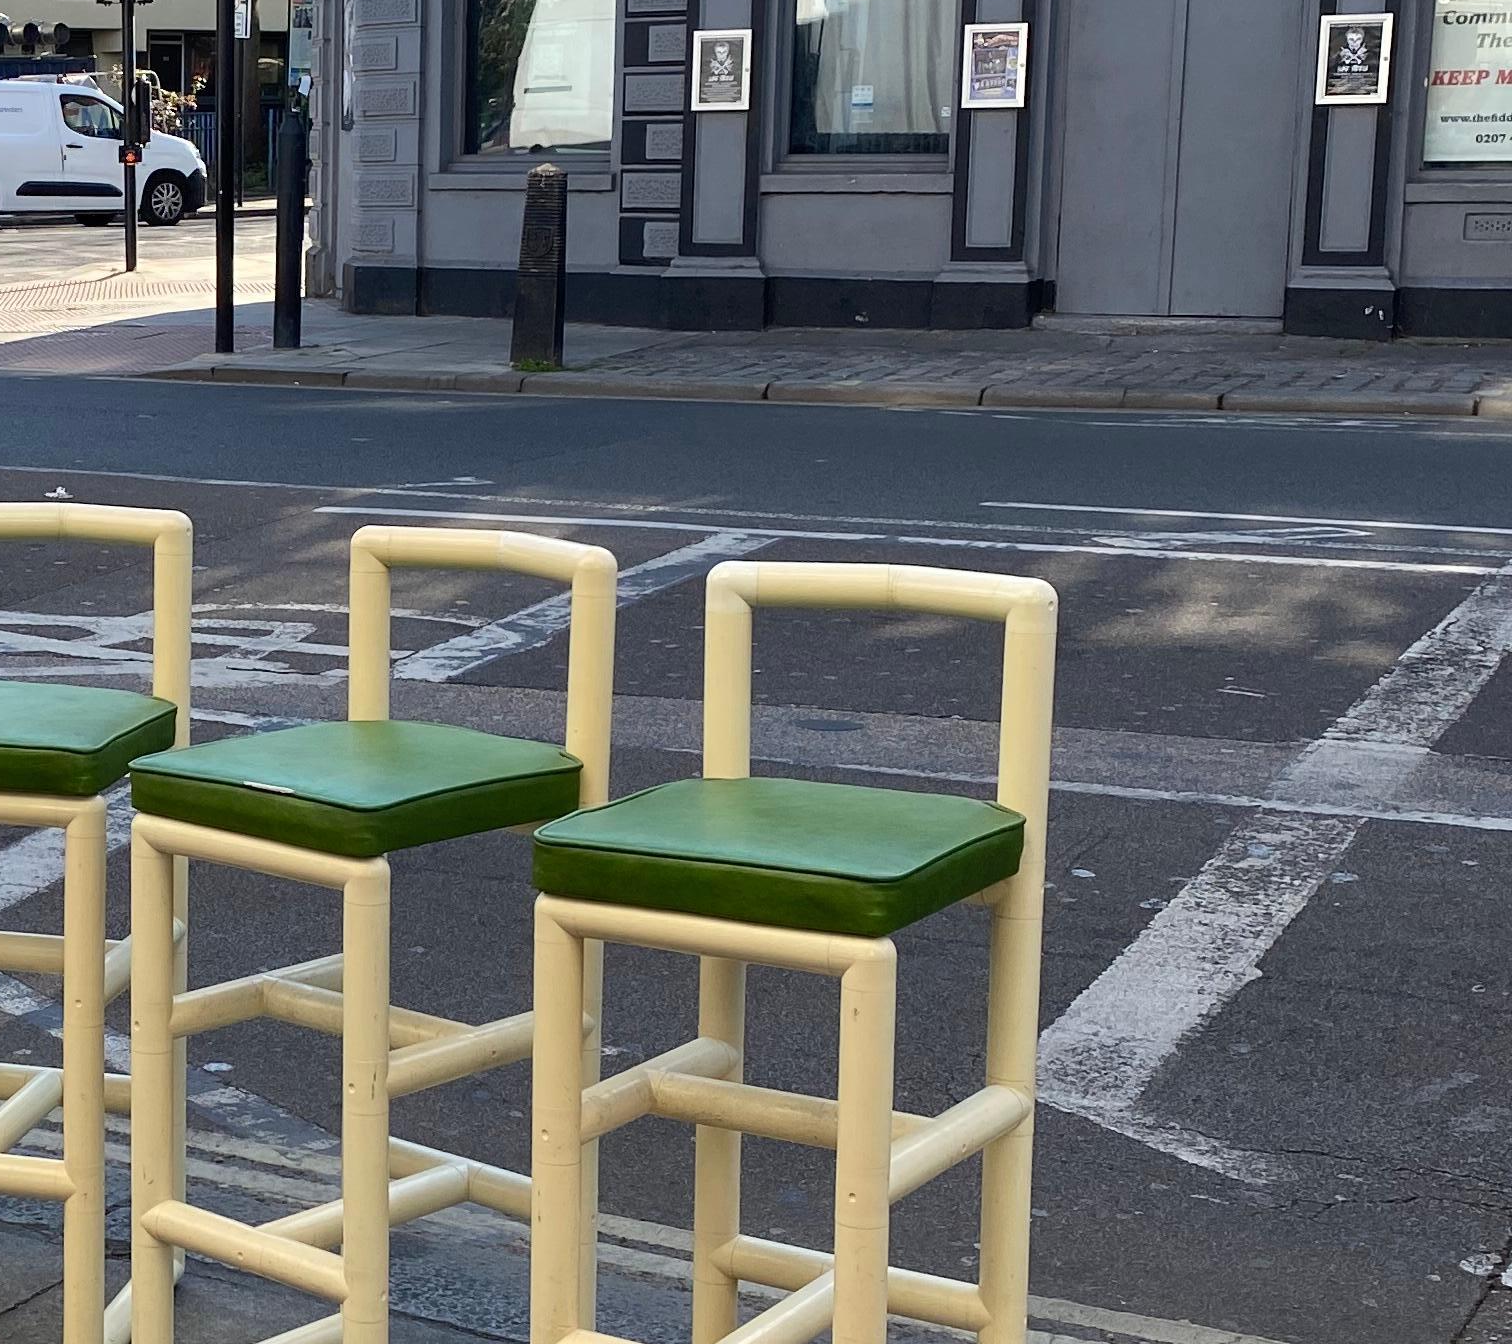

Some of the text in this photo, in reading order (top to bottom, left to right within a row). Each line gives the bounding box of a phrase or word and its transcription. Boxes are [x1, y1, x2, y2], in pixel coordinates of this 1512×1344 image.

[1443, 10, 1512, 24] Comm
[1431, 70, 1490, 85] KEEP
[1475, 133, 1506, 144] 0207
